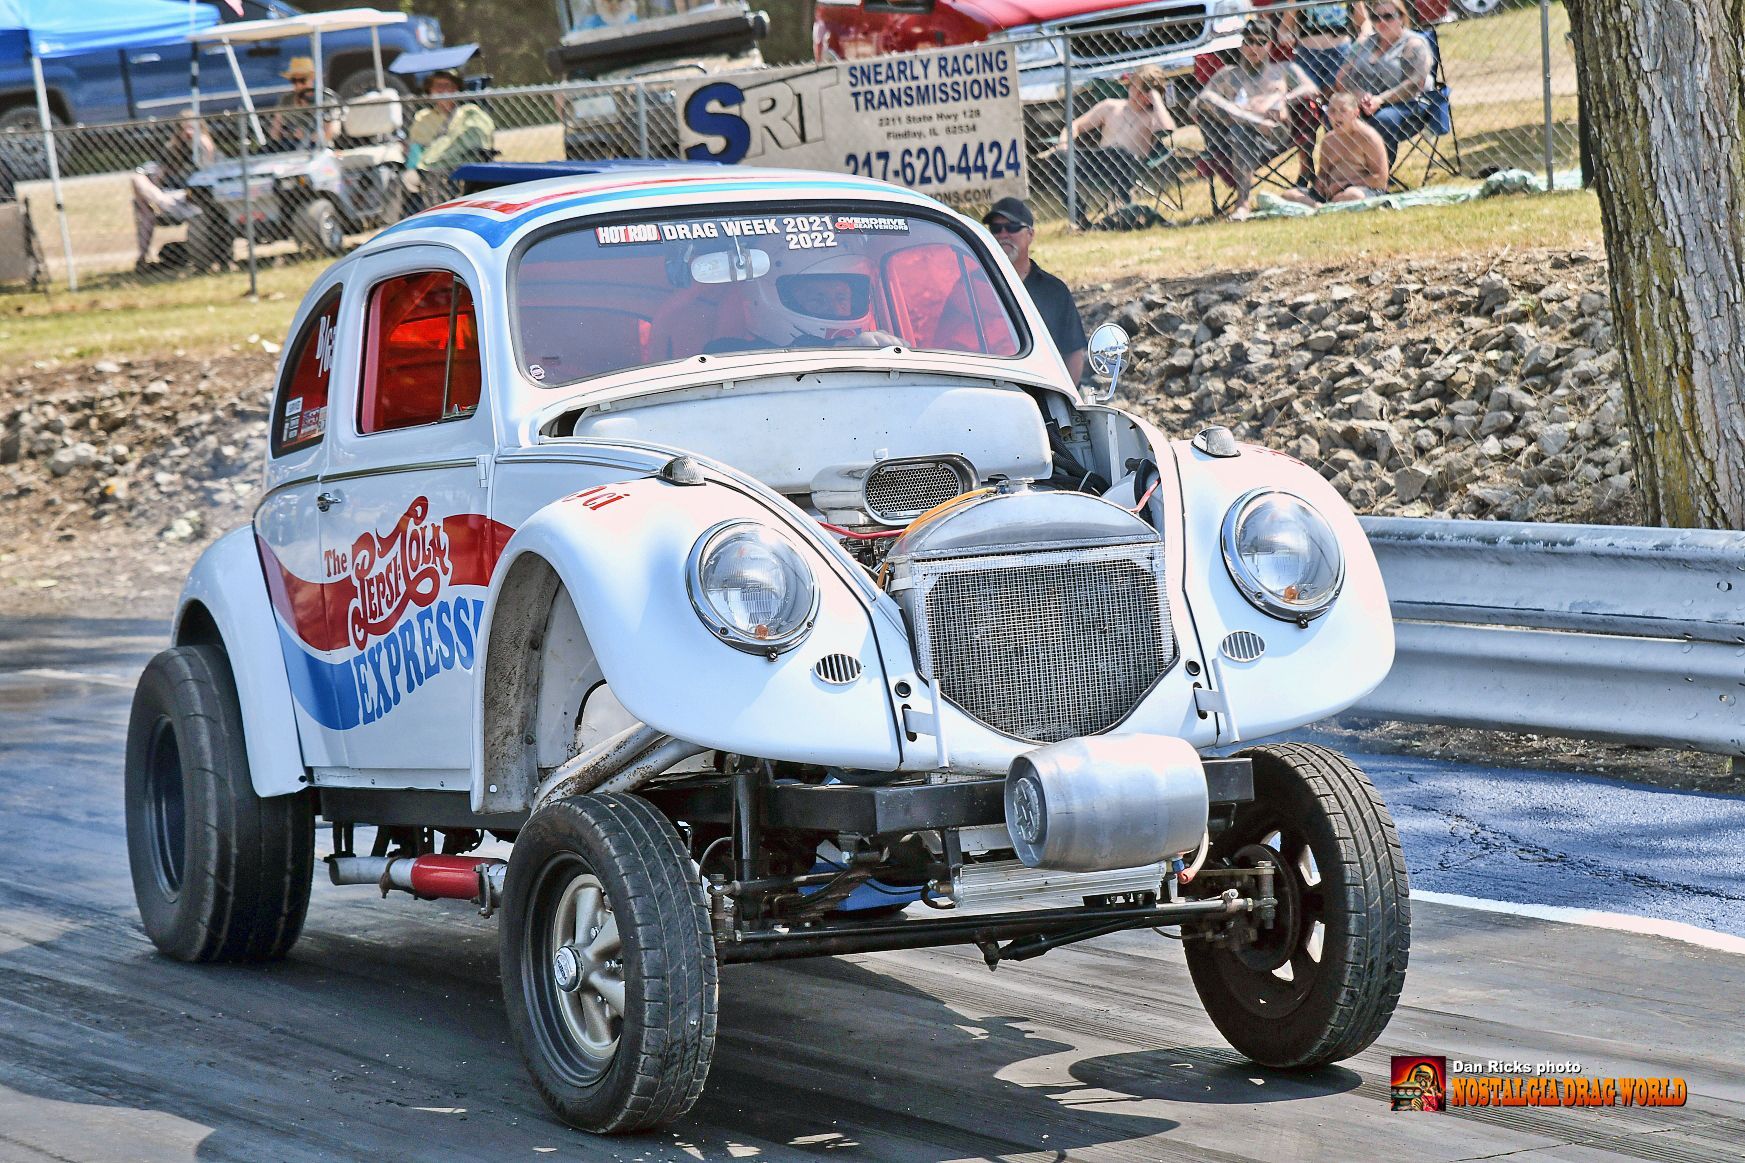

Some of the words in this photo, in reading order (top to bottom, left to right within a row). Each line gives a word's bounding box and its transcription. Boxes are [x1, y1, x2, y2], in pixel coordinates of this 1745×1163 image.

[849, 57, 931, 88] SNEARLY
[938, 50, 1008, 79] RACING
[851, 76, 1010, 112] TRANSMISSIONS
[684, 66, 839, 165] SRT
[906, 114, 933, 124] State
[936, 112, 958, 123] Hwy
[929, 127, 939, 137] IL
[845, 138, 1021, 187] 217-620-4424
[597, 225, 626, 244] HOT
[627, 223, 659, 242] ROD
[662, 222, 718, 240] DRAG
[721, 218, 780, 236] WEEK
[783, 216, 834, 234] 2021
[837, 217, 906, 226] OVERDRIVE
[786, 231, 838, 250] 2022
[324, 548, 348, 578] The
